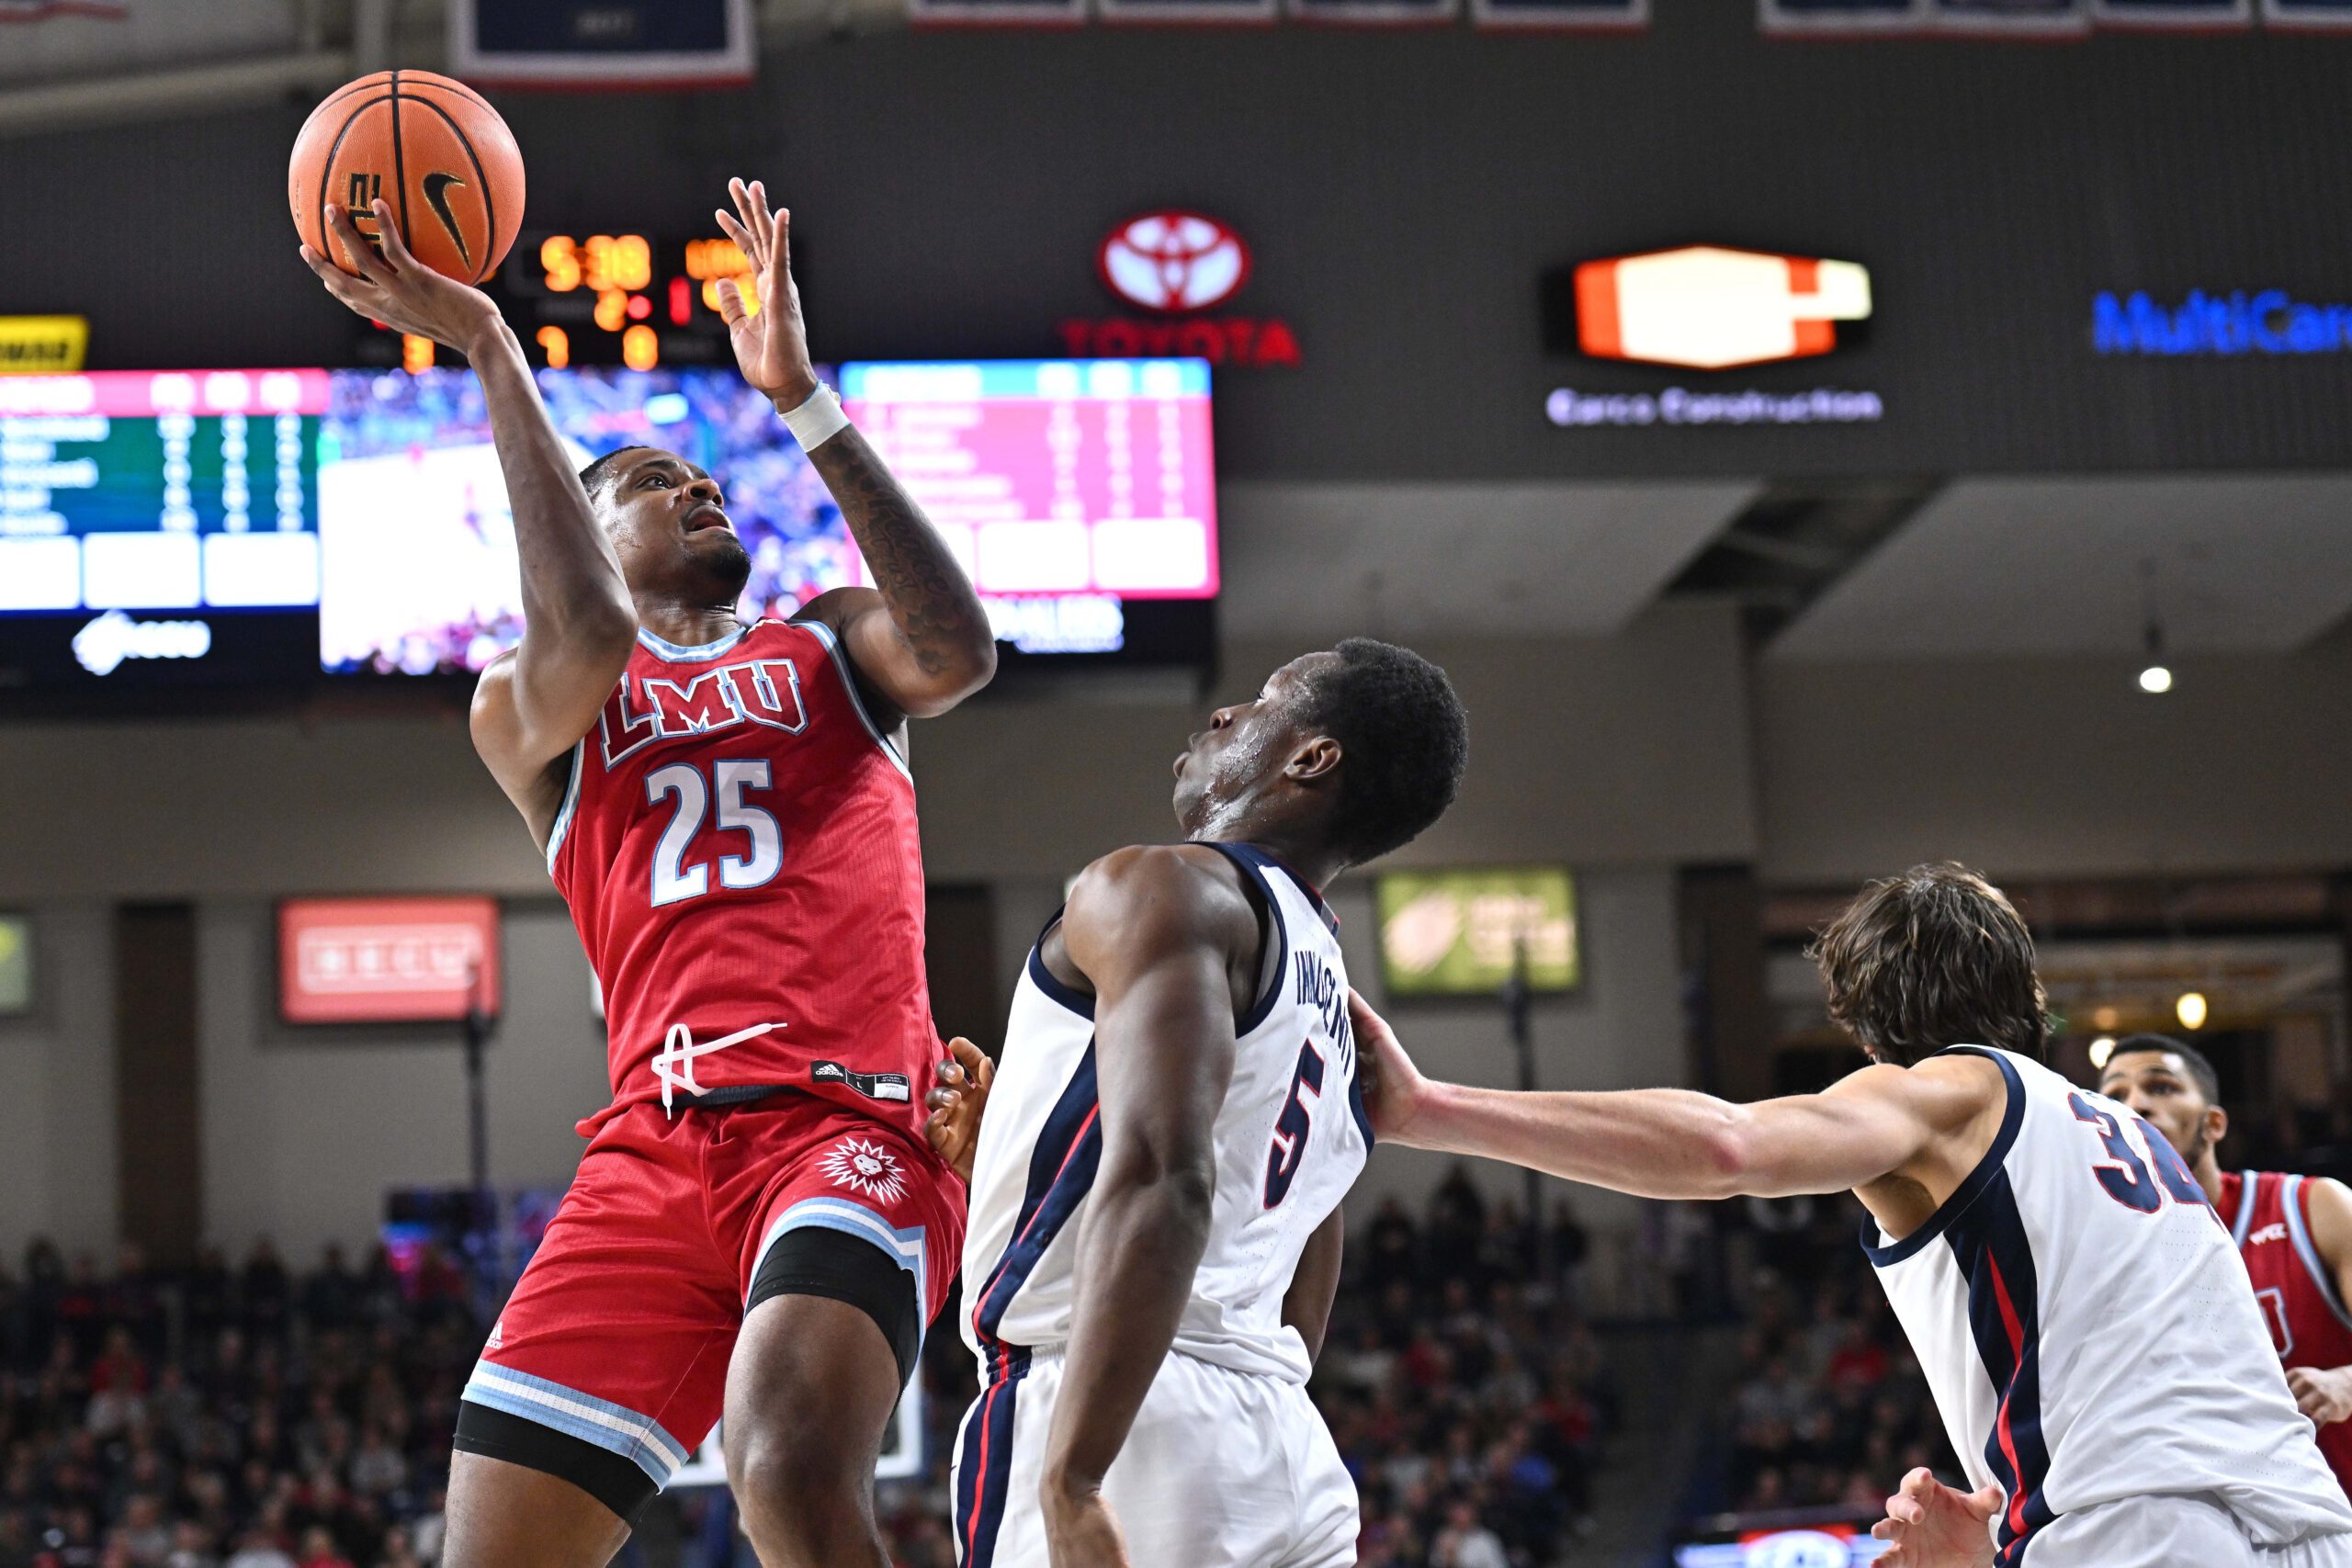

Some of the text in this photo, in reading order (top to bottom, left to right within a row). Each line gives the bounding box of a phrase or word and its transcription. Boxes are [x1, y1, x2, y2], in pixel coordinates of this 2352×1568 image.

[1060, 318, 1301, 365] TOYOTA
[2094, 288, 2352, 354] MultiCar
[1659, 387, 1883, 423] Construction
[600, 659, 808, 773] LMU
[645, 759, 783, 908] 25
[1263, 1037, 1325, 1210] 5
[2067, 1091, 2226, 1235] 34
